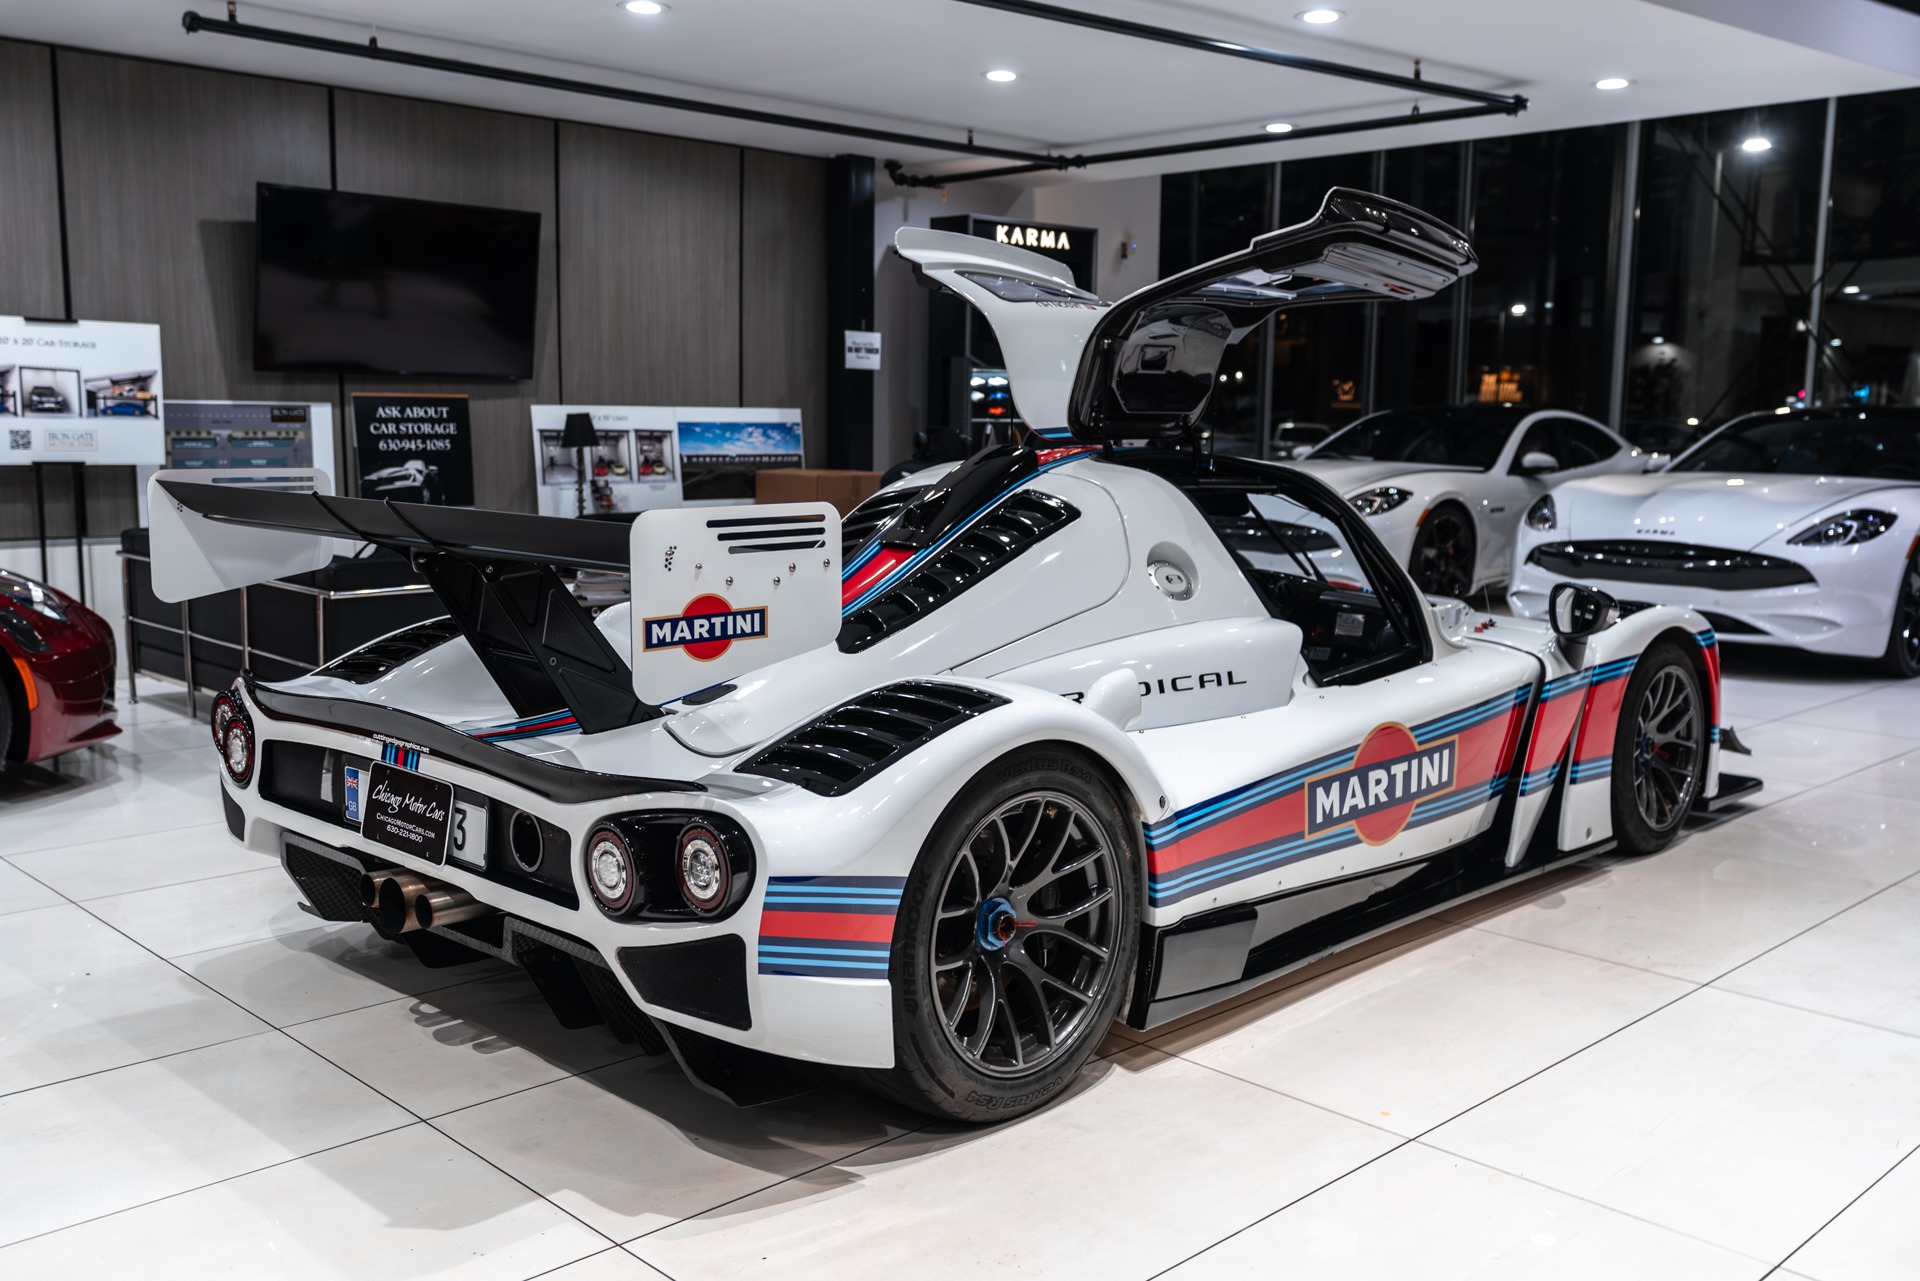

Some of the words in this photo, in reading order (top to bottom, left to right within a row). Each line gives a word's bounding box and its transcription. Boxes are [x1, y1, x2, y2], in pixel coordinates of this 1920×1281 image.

[996, 225, 1070, 250] KARMA
[376, 406, 402, 418] ASK
[404, 406, 450, 418] ABOUT
[48, 432, 70, 441] IRON
[72, 433, 95, 442] GATE
[369, 422, 397, 434] CAR
[399, 423, 458, 435] STORAGE
[378, 439, 451, 452] 630-945-1085
[651, 612, 761, 644] MARTINI
[1060, 670, 1247, 704] RDICAL
[372, 733, 430, 754] cuttingedgegraphics.net
[1316, 748, 1450, 824] MARTINI
[348, 800, 357, 812] GB
[372, 780, 403, 814] Chicago
[402, 793, 427, 815] Motor
[426, 803, 445, 822] Cars
[386, 824, 423, 843] 630-221-1800
[453, 807, 467, 852] 3
